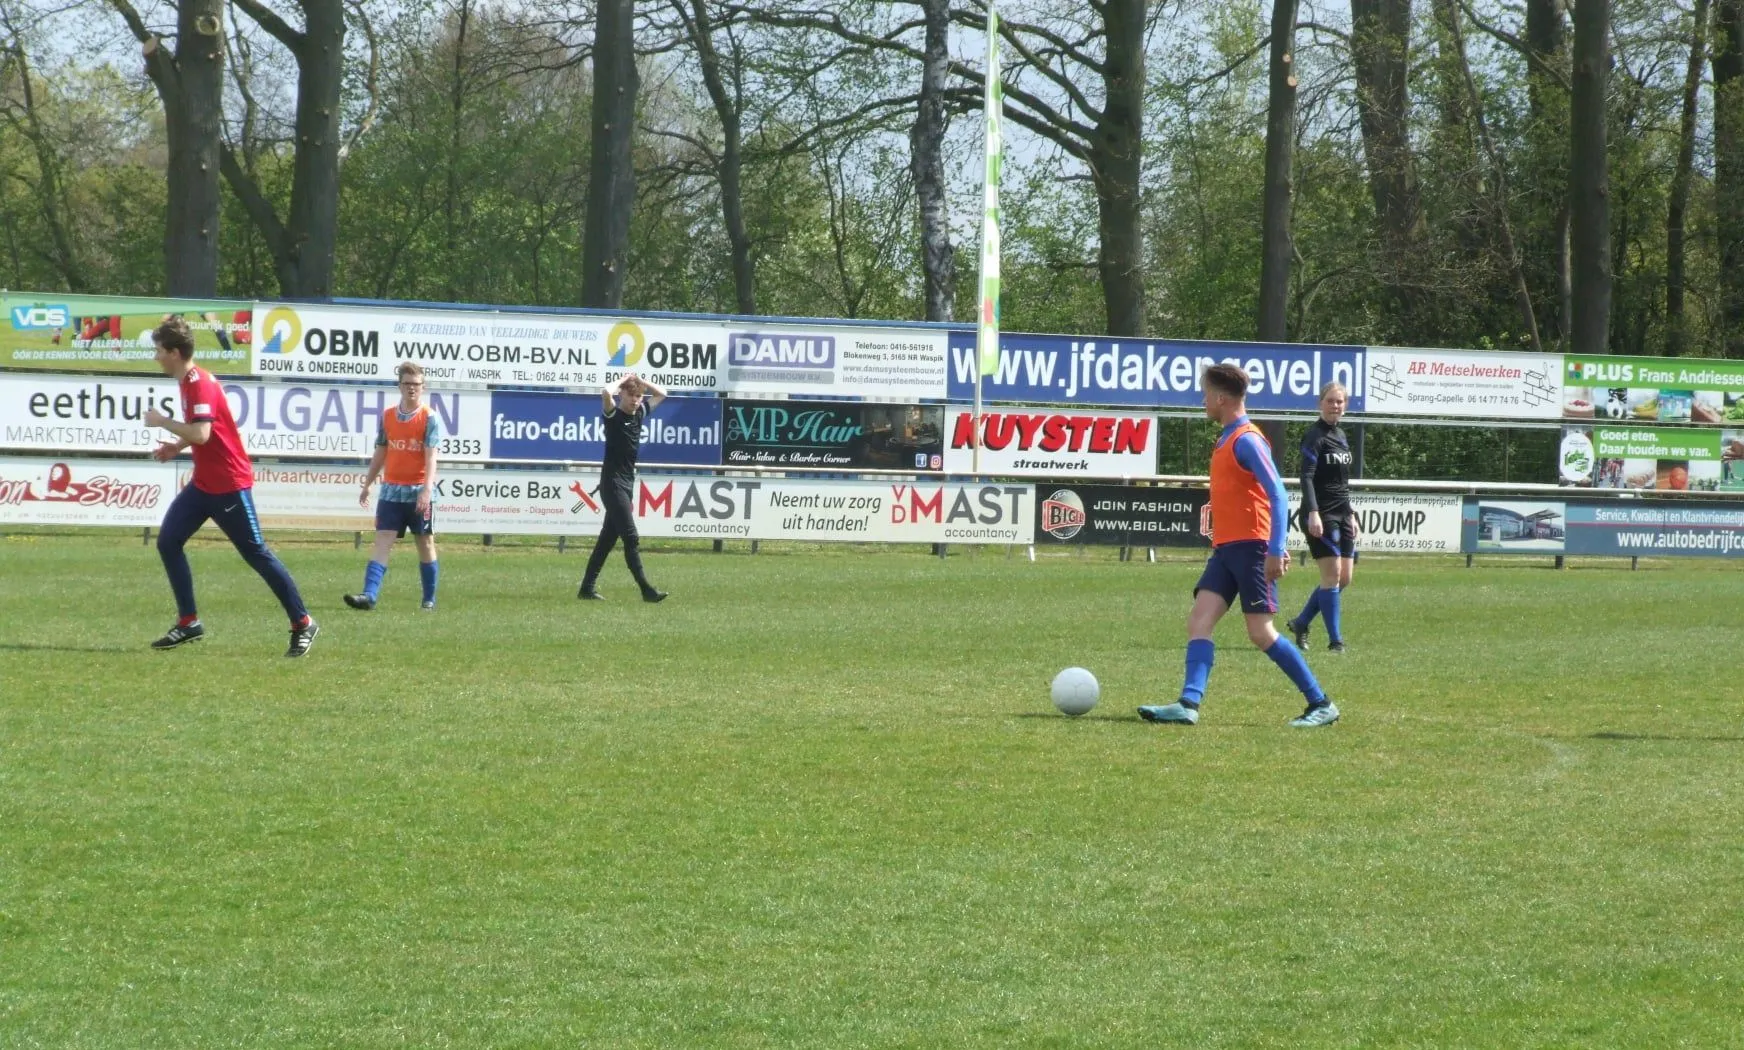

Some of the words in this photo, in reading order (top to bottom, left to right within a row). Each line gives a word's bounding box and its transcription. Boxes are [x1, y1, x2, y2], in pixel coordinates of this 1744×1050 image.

[14, 308, 66, 326] VOS
[226, 321, 249, 334] goed
[393, 322, 407, 333] DE
[410, 323, 467, 336] ZEKERHEID
[469, 325, 488, 337] VAN
[490, 327, 550, 340] VEELZIJDIGE
[552, 328, 600, 341] BOUWERS
[71, 339, 91, 348] NIET
[91, 339, 121, 348] ALLEEN
[124, 339, 136, 348] DE
[304, 327, 379, 358] OBM
[734, 337, 830, 364] DAMU
[855, 341, 888, 350] Telefoon:
[33, 351, 44, 360] DE
[45, 351, 77, 360] KENNIS
[78, 350, 101, 360] VOOR
[120, 351, 156, 360] GEZOND
[205, 350, 220, 359] UW
[393, 340, 597, 366] WWW.OBM-BV.NL
[646, 341, 718, 370] OBM
[919, 354, 944, 363] Waspik
[259, 359, 294, 372] BOUW
[296, 360, 305, 372] &
[308, 361, 379, 375] ONDERHOUD
[467, 368, 502, 380] WASPIK
[536, 371, 556, 382] 0162
[558, 372, 570, 382] 44
[573, 372, 583, 383] 79
[586, 373, 597, 383] 45
[1407, 361, 1427, 375] AR
[1429, 361, 1522, 379] Metselwerken
[1583, 362, 1634, 382] PLUS
[1638, 368, 1675, 384] Frans
[1678, 369, 1744, 385] Andriesse
[650, 373, 717, 388] ONDERHOUD
[29, 384, 175, 420] eethuis
[1407, 392, 1464, 404] Sprang-Capelle
[1467, 394, 1477, 403] 06
[1479, 394, 1487, 403] 14
[1488, 395, 1498, 404] 77
[1499, 395, 1509, 404] 74
[6, 425, 127, 445] MARKTSTRAAT
[131, 429, 150, 446] 19
[494, 413, 720, 446] faro-dakkellen.nl
[788, 410, 865, 443] Hair
[951, 412, 1151, 455] KUYSTEN
[247, 432, 358, 453] KAATSHEUVEL
[1600, 430, 1629, 442] Goed
[1631, 431, 1659, 442] eten.
[438, 438, 482, 456] 3353
[1599, 443, 1625, 455] Daar
[1627, 444, 1669, 456] houden
[1671, 447, 1686, 457] we
[1688, 448, 1712, 458] van.
[728, 449, 751, 462] Hair
[752, 450, 776, 463] Salon
[778, 453, 787, 462] &
[789, 452, 822, 463] Barber
[822, 452, 851, 464] Corner
[1012, 458, 1089, 471] straatwerk
[79, 475, 162, 509] Stone
[451, 479, 522, 499] Service
[527, 480, 562, 500] Bax
[638, 479, 762, 520] MAST
[769, 490, 820, 508] Neemt
[823, 496, 847, 509] uw
[848, 496, 882, 514] zorg
[910, 485, 1028, 525] MAST
[1093, 500, 1127, 512] JOIN
[1131, 501, 1193, 514] FASHION
[1392, 497, 1414, 507] tegen
[480, 504, 521, 516] Reparaties
[1595, 508, 1630, 523] Service,
[1631, 508, 1669, 523] Kwaliteit
[1670, 512, 1680, 523] en
[1682, 510, 1744, 527] Klantvriendelij
[673, 522, 751, 537] accountancy
[782, 514, 804, 531] uit
[805, 514, 869, 532] handen!
[1093, 519, 1191, 533] WWW.BIGL.NL
[944, 527, 1018, 542] accountancy
[1371, 539, 1383, 549] tel:
[1385, 539, 1397, 549] 06
[1399, 540, 1415, 550] 532
[1416, 540, 1433, 550] 305
[1435, 540, 1446, 550] 22
